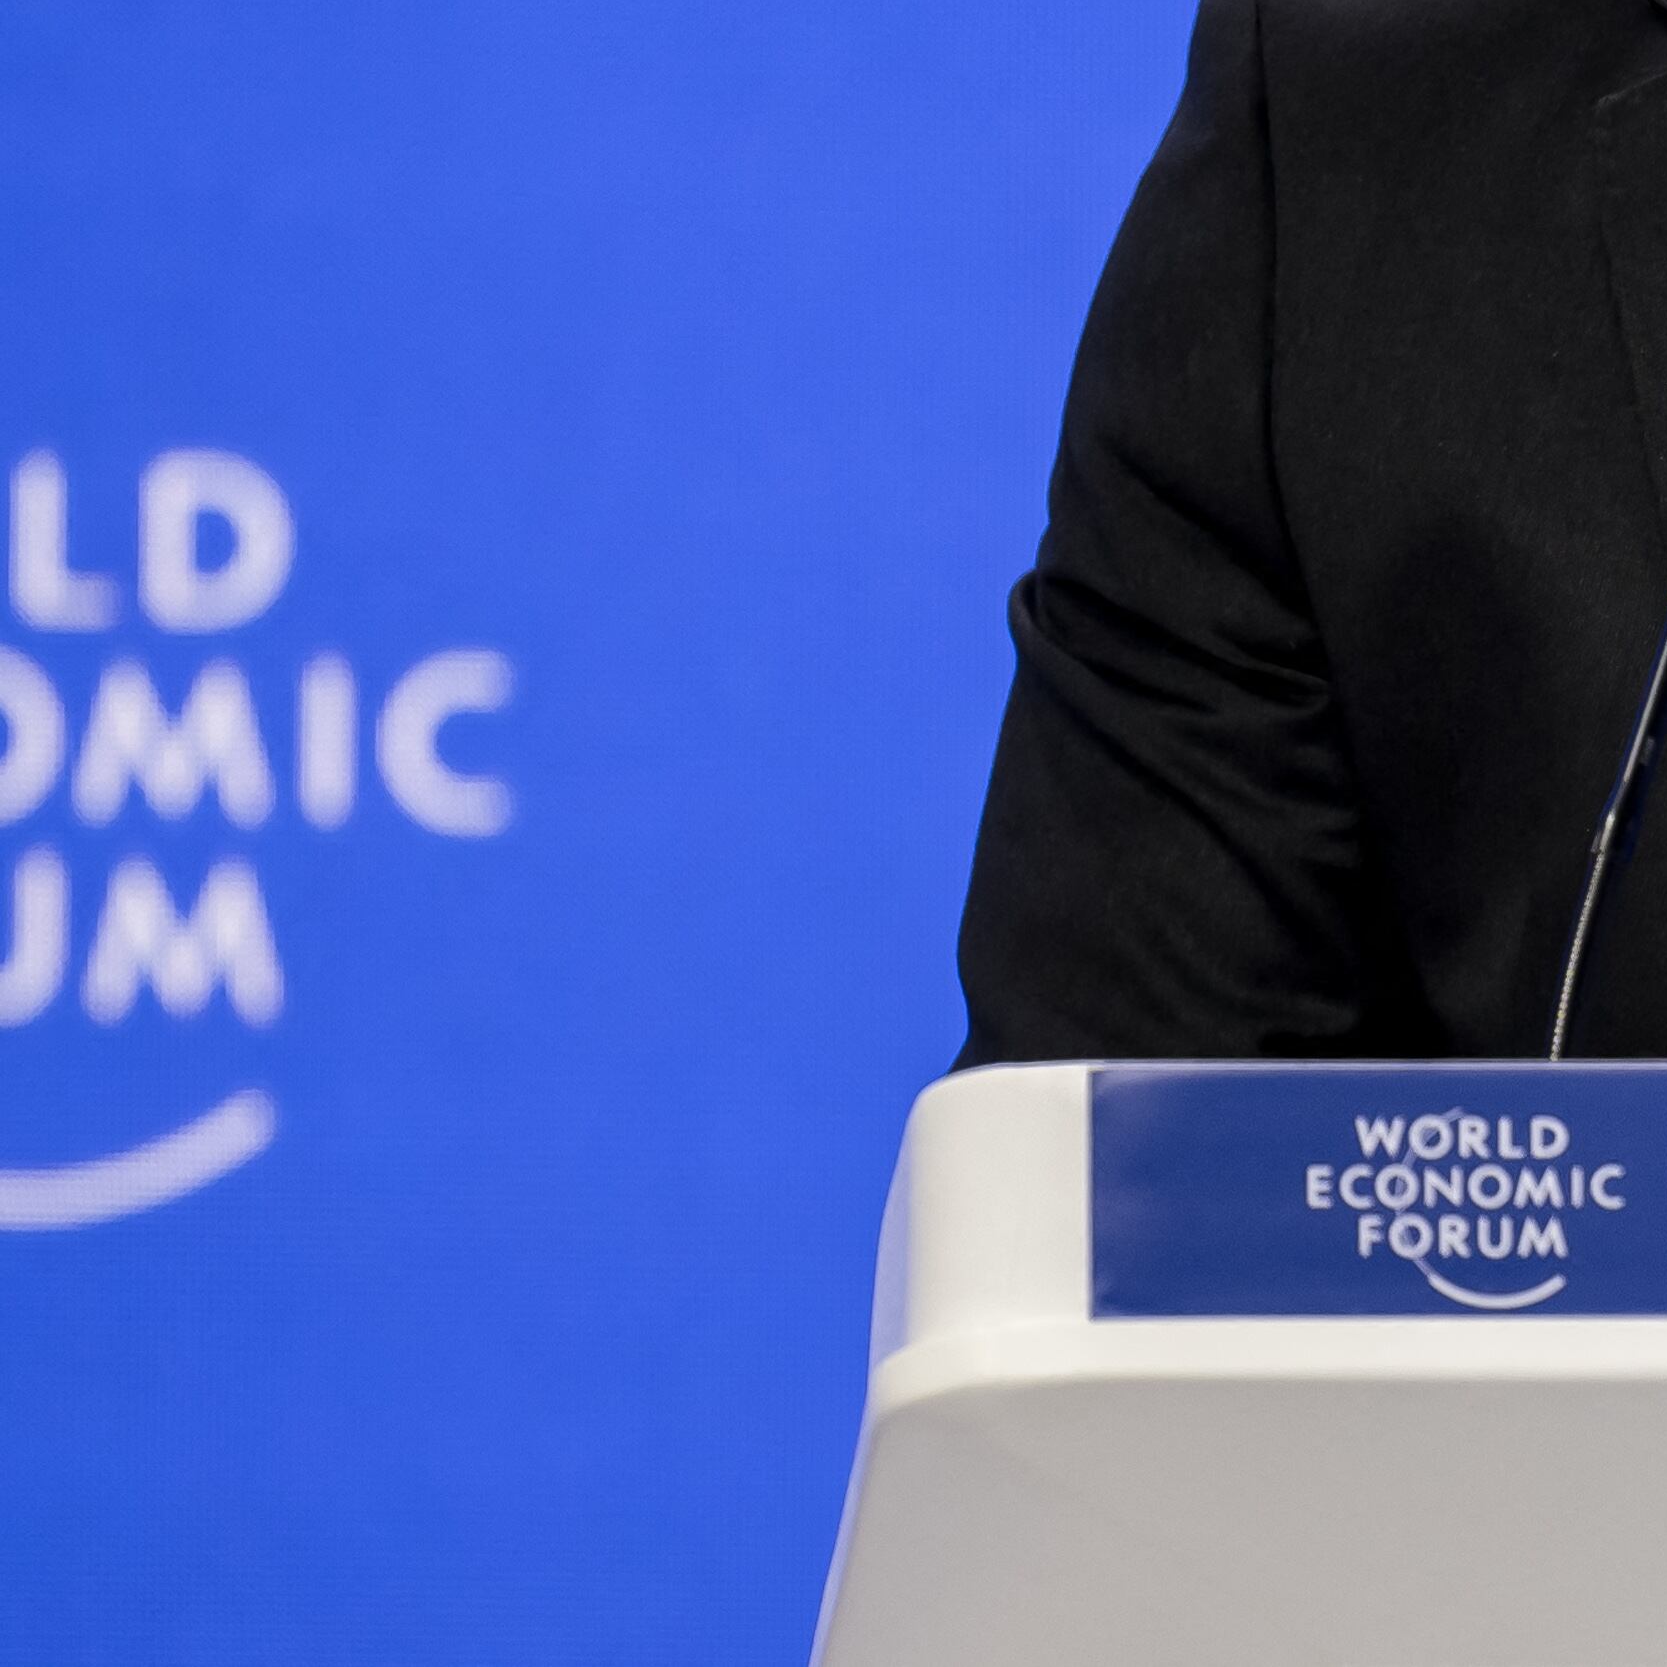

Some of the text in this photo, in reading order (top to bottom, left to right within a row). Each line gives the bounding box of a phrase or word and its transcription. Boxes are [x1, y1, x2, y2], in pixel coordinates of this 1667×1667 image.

[1355, 1115, 1570, 1160] WORLD
[1305, 1161, 1627, 1211] ECONOMIC
[1356, 1213, 1568, 1259] FORUM
